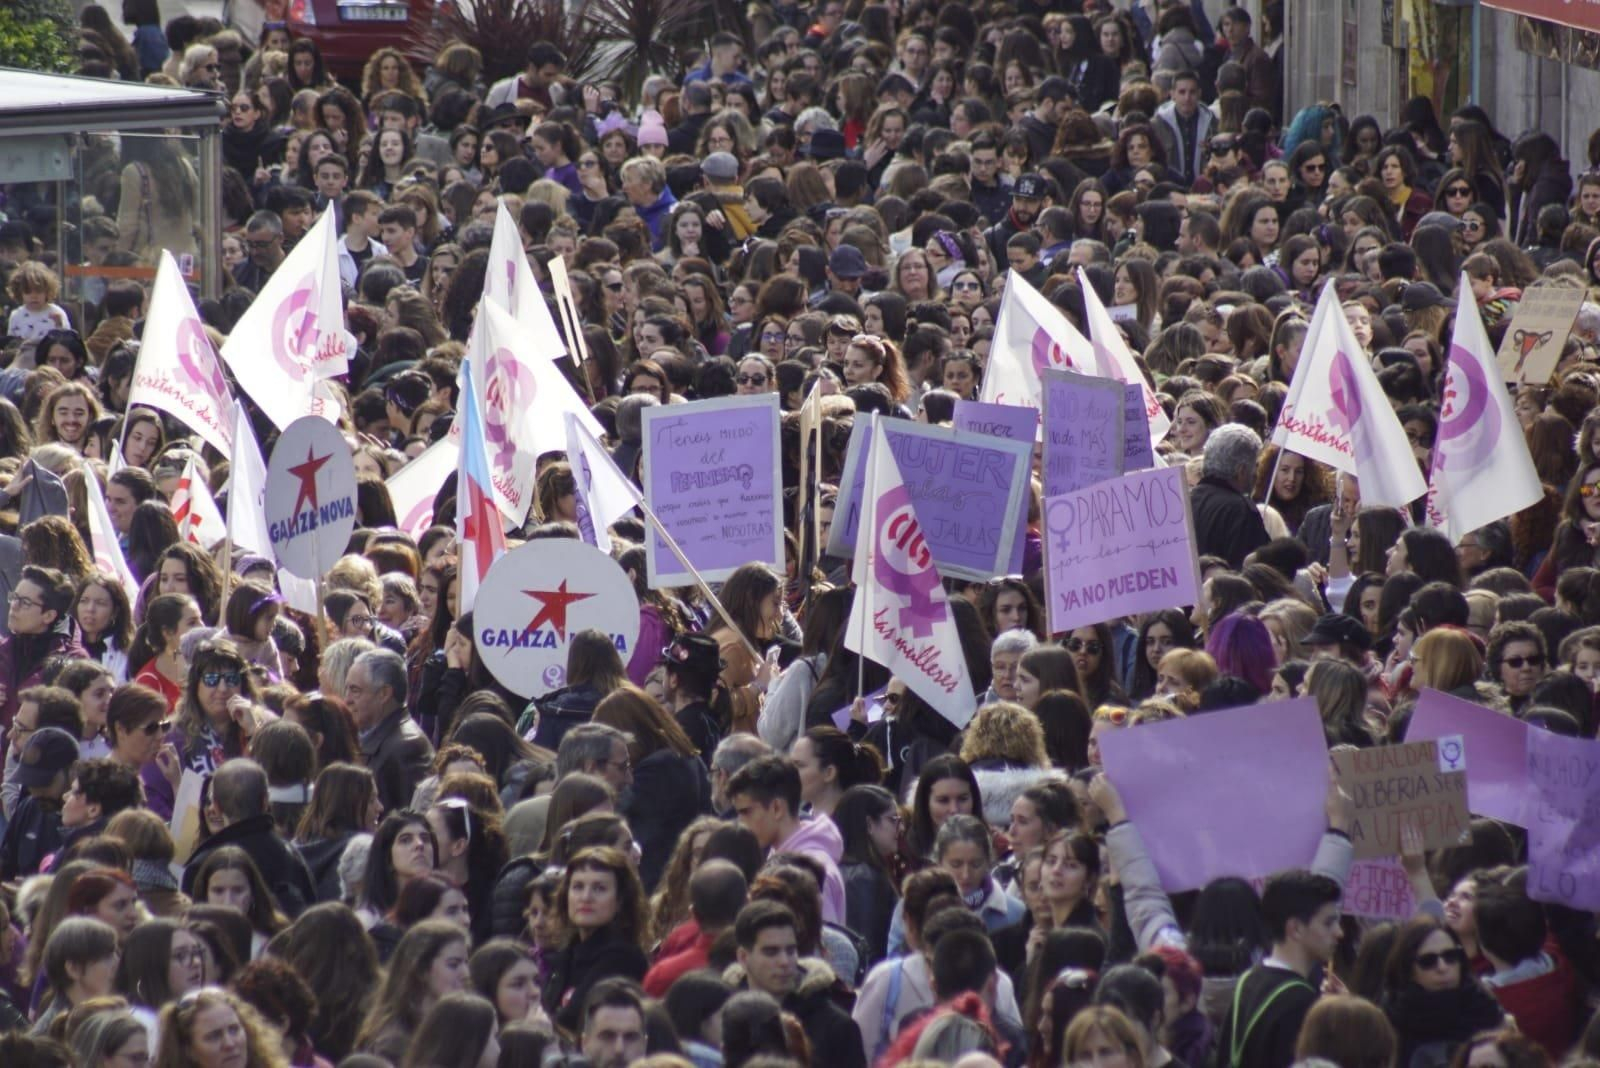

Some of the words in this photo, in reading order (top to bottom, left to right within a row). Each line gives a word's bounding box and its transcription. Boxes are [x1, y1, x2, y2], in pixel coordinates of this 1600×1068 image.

[319, 496, 354, 527] NOVA
[1076, 475, 1185, 546] PARAMOS
[721, 521, 774, 539] NOSOTRAS
[887, 512, 931, 569] CIG
[930, 517, 1001, 552] JAULAS
[1136, 536, 1188, 557] que
[1060, 588, 1081, 612] YA
[1082, 583, 1106, 607] NO
[1107, 566, 1178, 600] PUEDEN
[481, 628, 557, 649] GALIZA
[894, 637, 959, 694] mulleres
